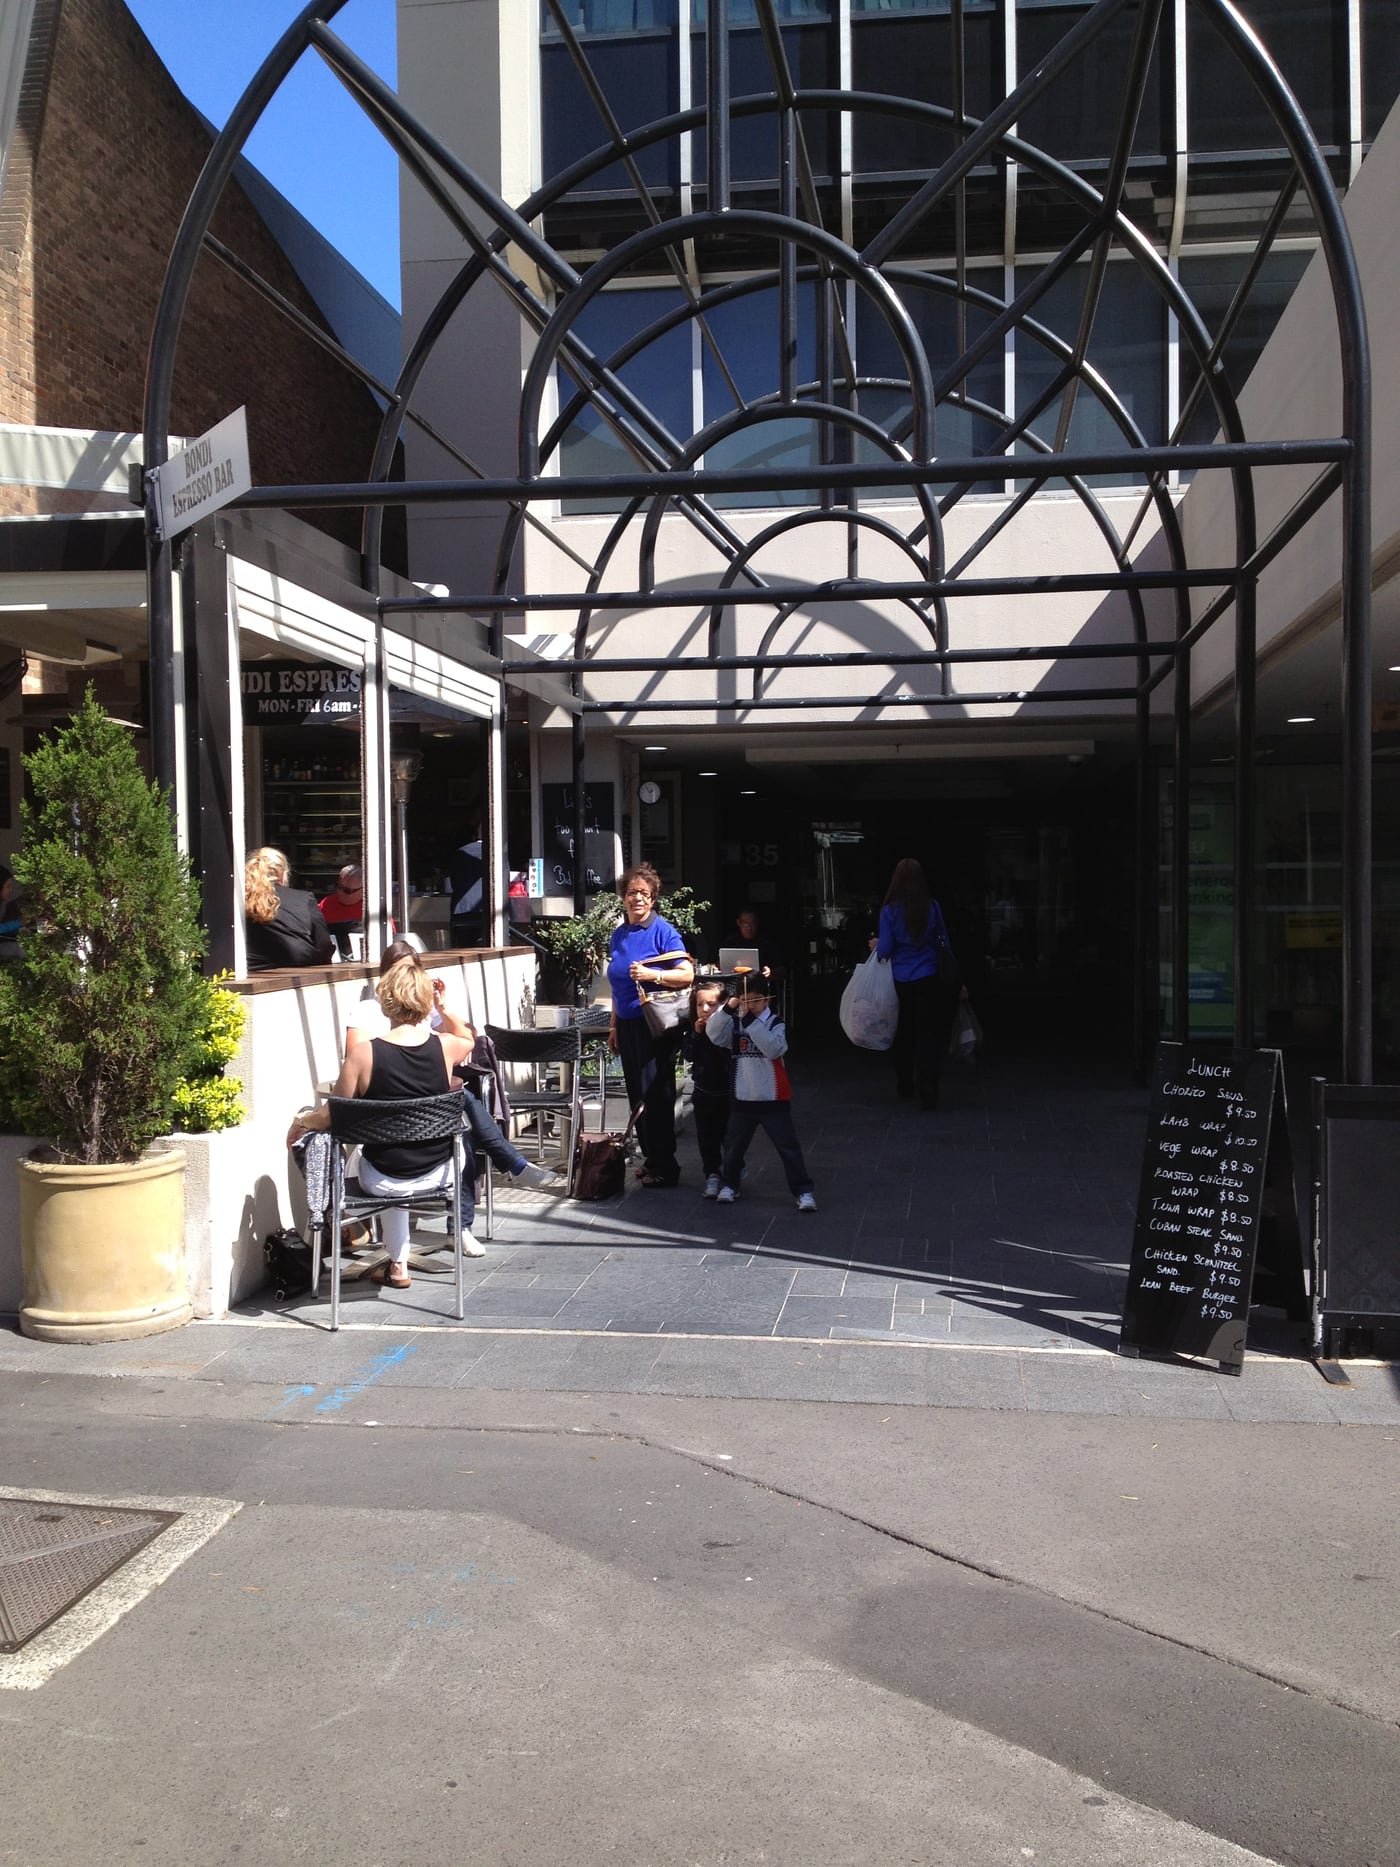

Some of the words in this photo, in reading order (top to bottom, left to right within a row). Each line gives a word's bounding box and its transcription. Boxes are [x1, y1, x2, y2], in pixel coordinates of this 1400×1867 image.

[184, 439, 212, 479] BONDI
[172, 471, 212, 518] ESPRESSO
[214, 458, 234, 494] BAR
[745, 844, 779, 866] 35
[1187, 1058, 1232, 1077] LUNCH
[1160, 1113, 1189, 1127] LAMB
[1191, 1146, 1218, 1158] WRAP
[1199, 1174, 1243, 1188] CHICKEN
[1171, 1186, 1199, 1197] WRAP
[1152, 1197, 1180, 1214] TUNA
[1187, 1205, 1215, 1218] WRAP
[1149, 1217, 1182, 1233] CUBAN
[1186, 1225, 1213, 1238] STEAK
[1144, 1247, 1188, 1262] CHICKEN
[1193, 1253, 1242, 1272] SCHNITZEL
[1140, 1277, 1161, 1289] LEAN
[1168, 1281, 1195, 1294] BEEF
